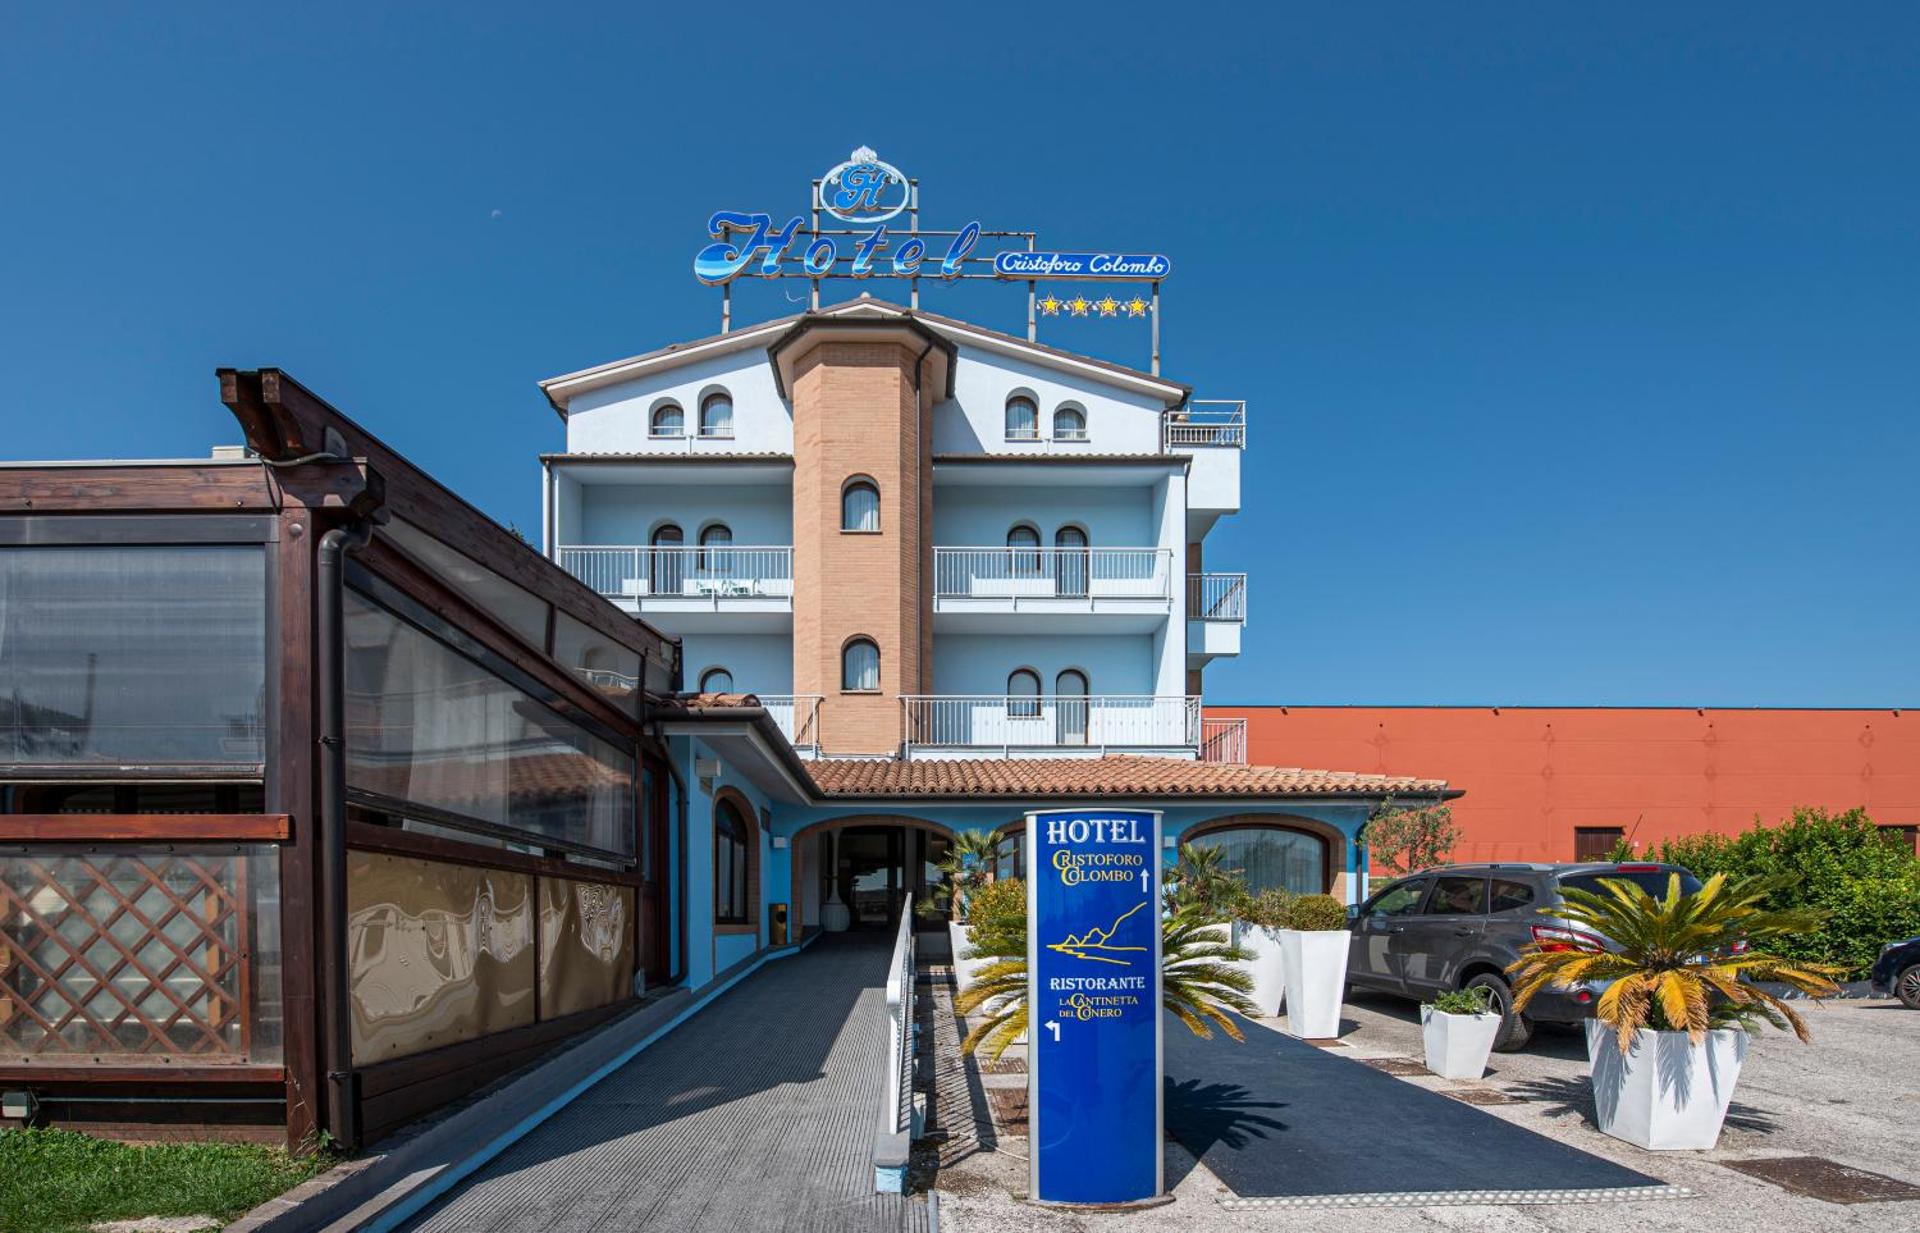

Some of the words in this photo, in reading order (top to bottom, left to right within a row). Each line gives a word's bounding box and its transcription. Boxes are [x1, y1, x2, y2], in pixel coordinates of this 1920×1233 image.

[694, 211, 981, 283] Hotel
[1002, 253, 1083, 274] Cristoforo
[1090, 254, 1165, 273] Colombo
[1047, 819, 1146, 844] HOTEL
[1052, 849, 1143, 870] CRISTOFORO
[1061, 865, 1134, 886] COLOMBO
[1050, 976, 1146, 991] RISTORANTE
[1059, 998, 1073, 1006] LA
[1070, 992, 1139, 1009] CANTINETTA
[1059, 1010, 1076, 1018] DEL
[1077, 1005, 1122, 1021] CONERO
